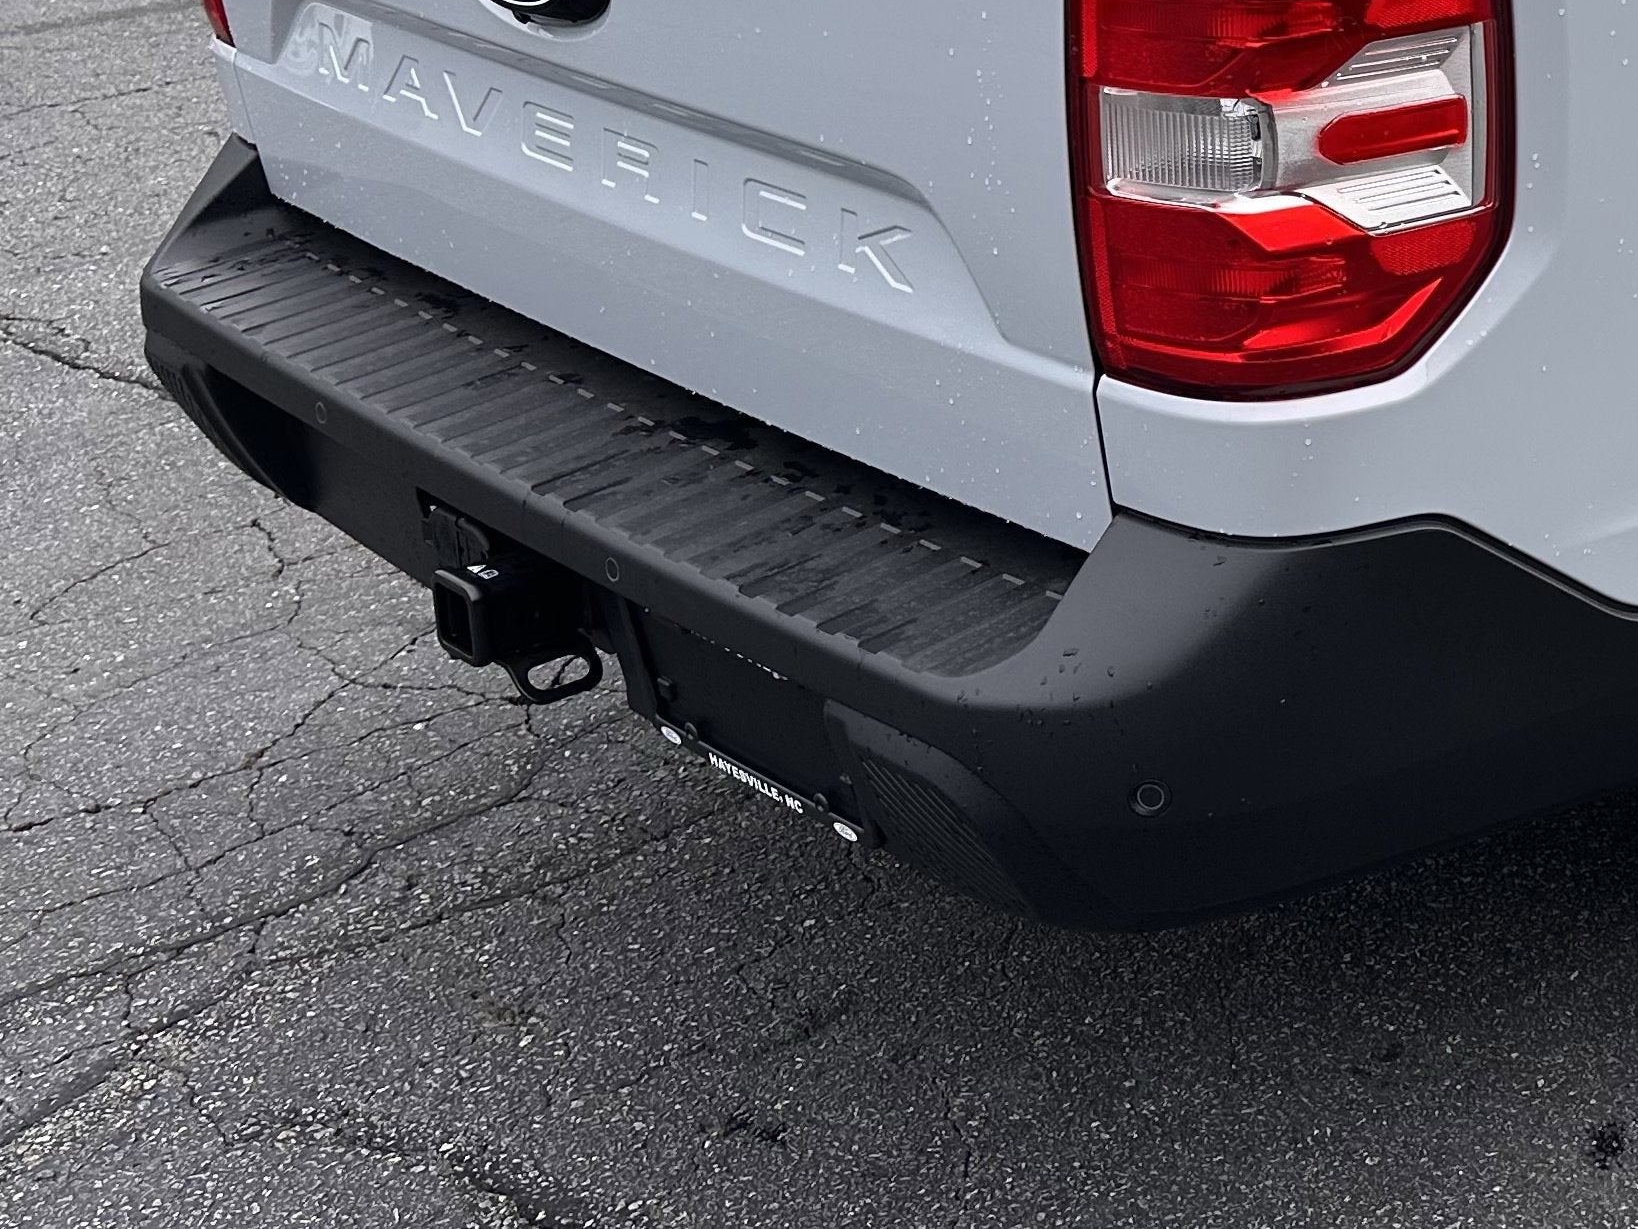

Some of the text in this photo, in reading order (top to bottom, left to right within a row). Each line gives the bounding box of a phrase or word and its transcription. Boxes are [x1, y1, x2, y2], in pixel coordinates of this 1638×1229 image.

[318, 21, 914, 294] MAVERICK
[709, 752, 804, 815] HAYESVILLE, NC
